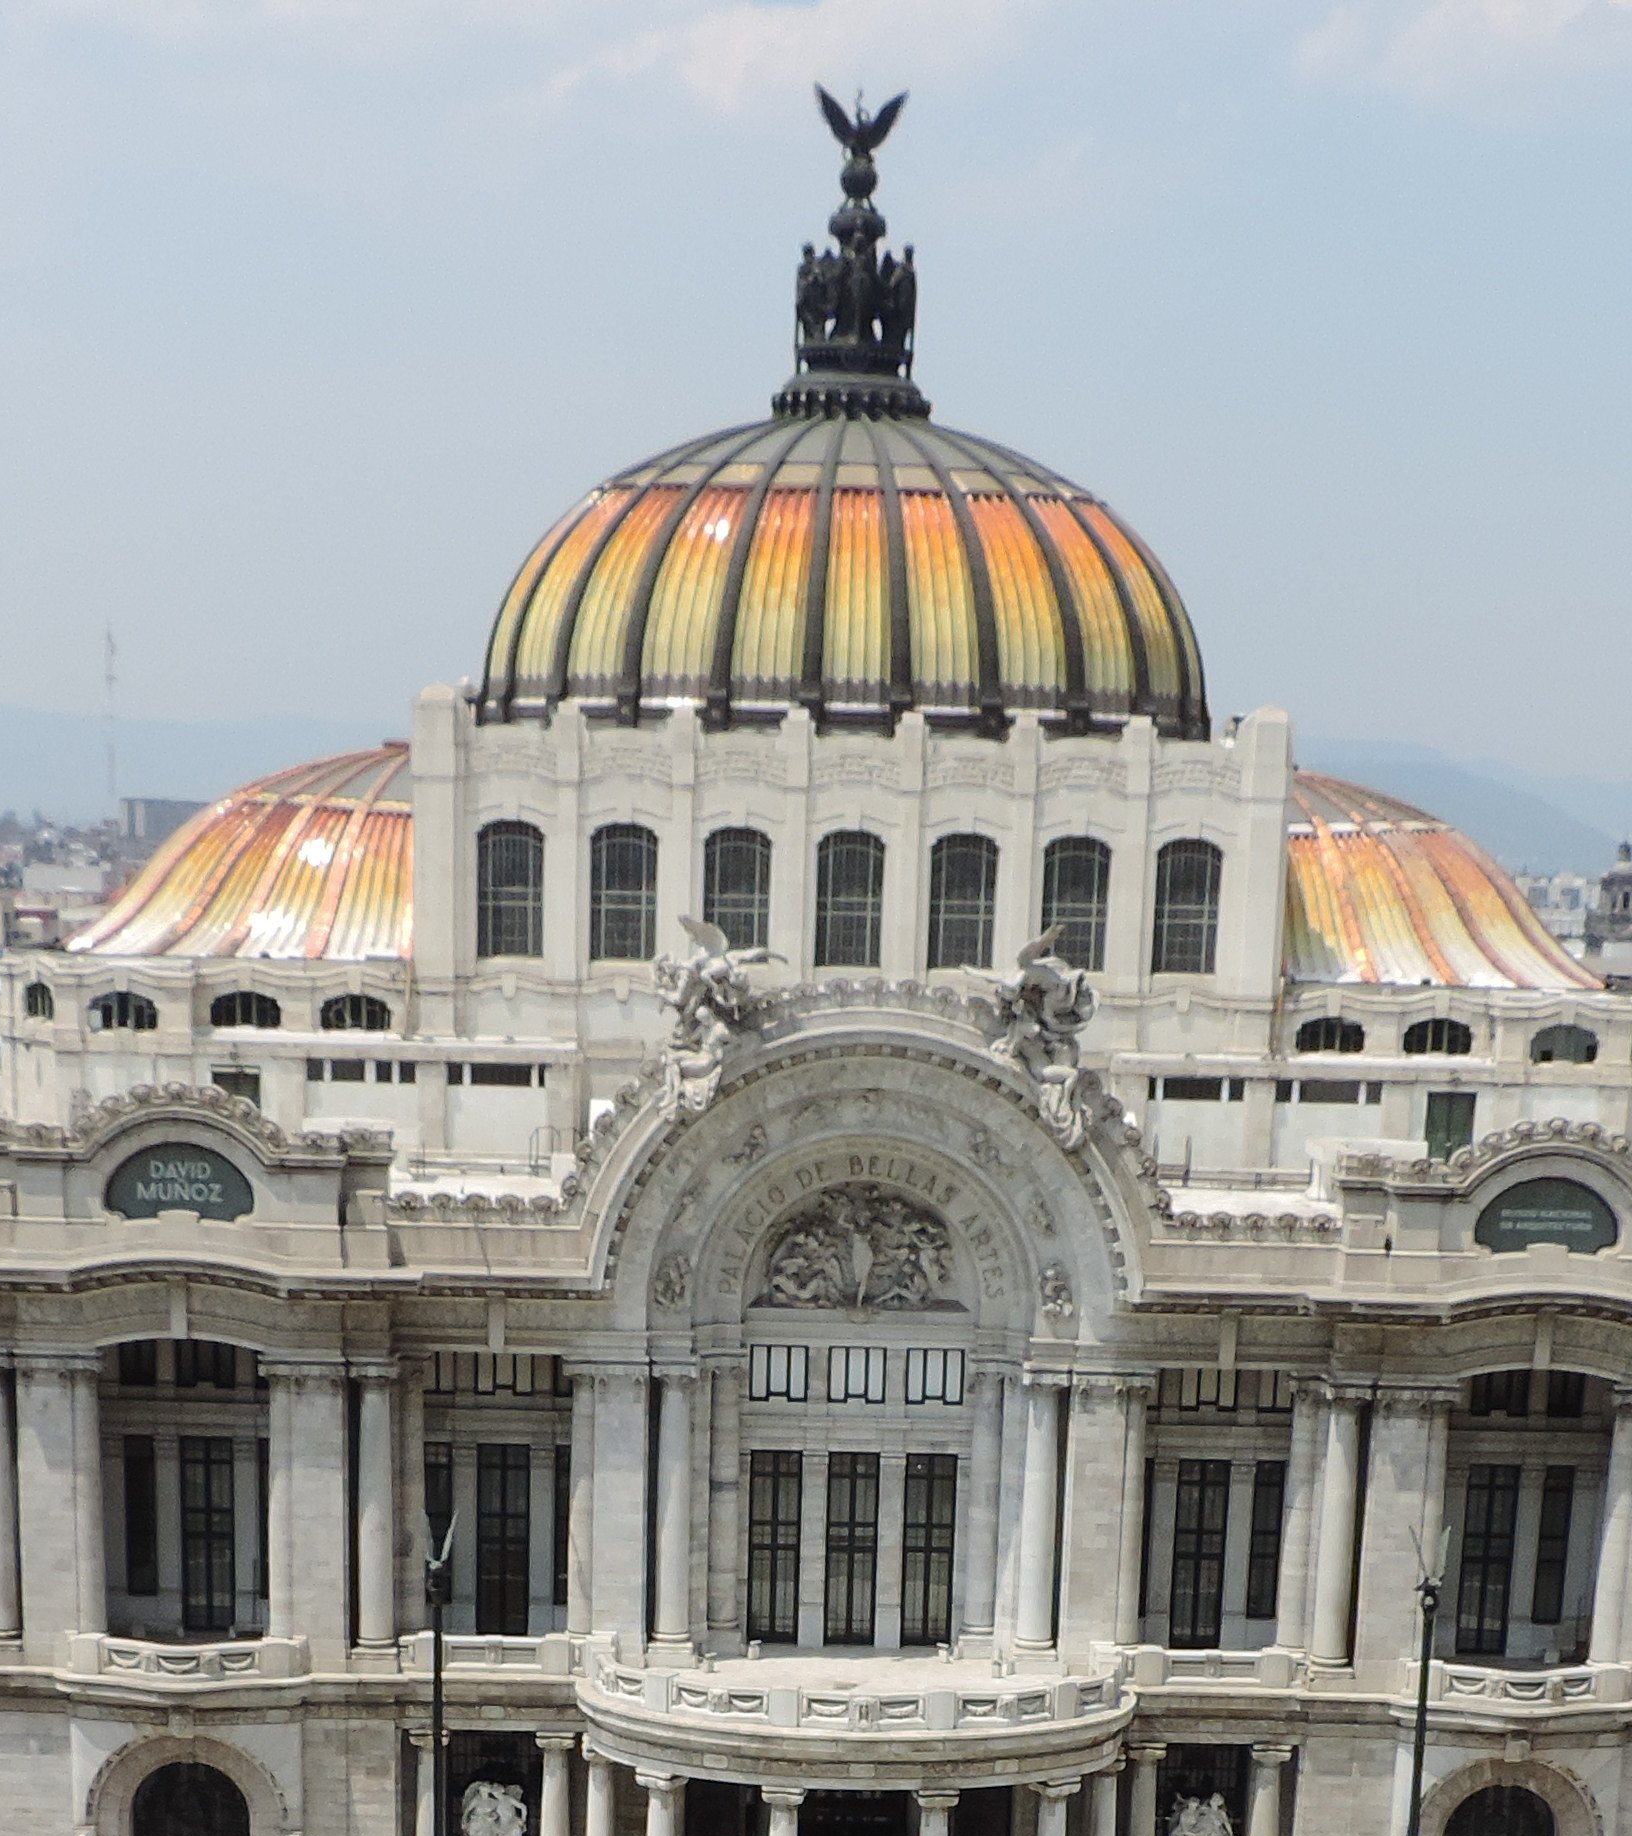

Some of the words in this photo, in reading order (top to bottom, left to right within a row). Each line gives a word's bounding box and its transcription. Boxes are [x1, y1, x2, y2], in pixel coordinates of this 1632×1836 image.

[149, 1160, 211, 1179] DAVID
[136, 1179, 224, 1203] MUÑOZ
[718, 1183, 786, 1295] PALACIO
[794, 1160, 832, 1189] DE
[848, 1154, 960, 1204] BELLAS
[959, 1213, 1005, 1299] ARTES
